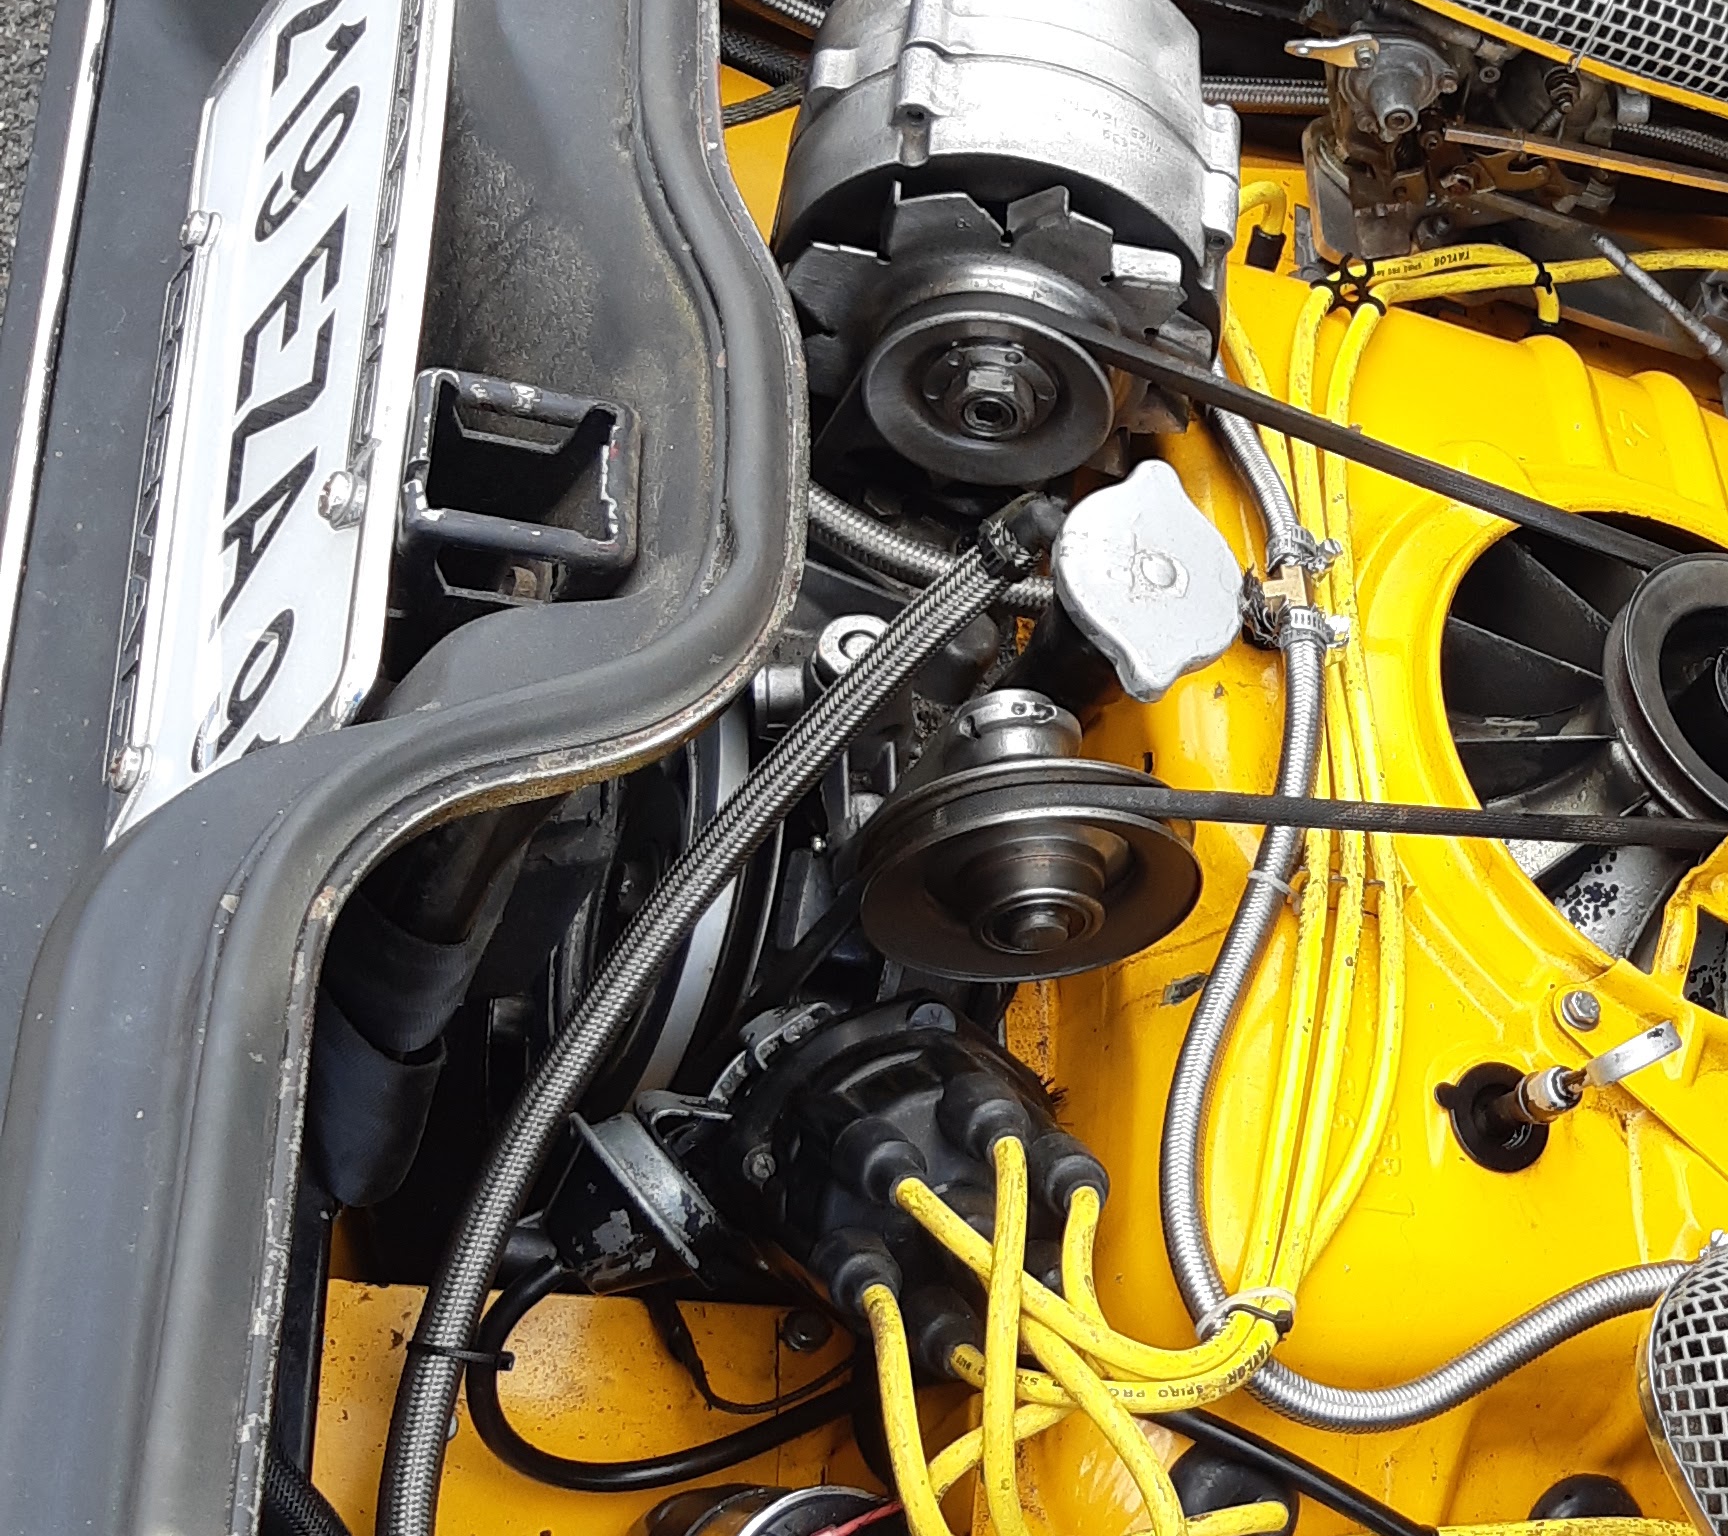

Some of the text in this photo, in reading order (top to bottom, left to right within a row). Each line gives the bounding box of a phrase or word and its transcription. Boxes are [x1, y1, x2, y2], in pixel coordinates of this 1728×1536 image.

[1433, 250, 1471, 267] TAYLOR
[212, 202, 350, 632] EZA
[190, 608, 296, 773] 9
[1225, 1338, 1272, 1386] TAYLOR
[1157, 1384, 1204, 1401] SPIRO
